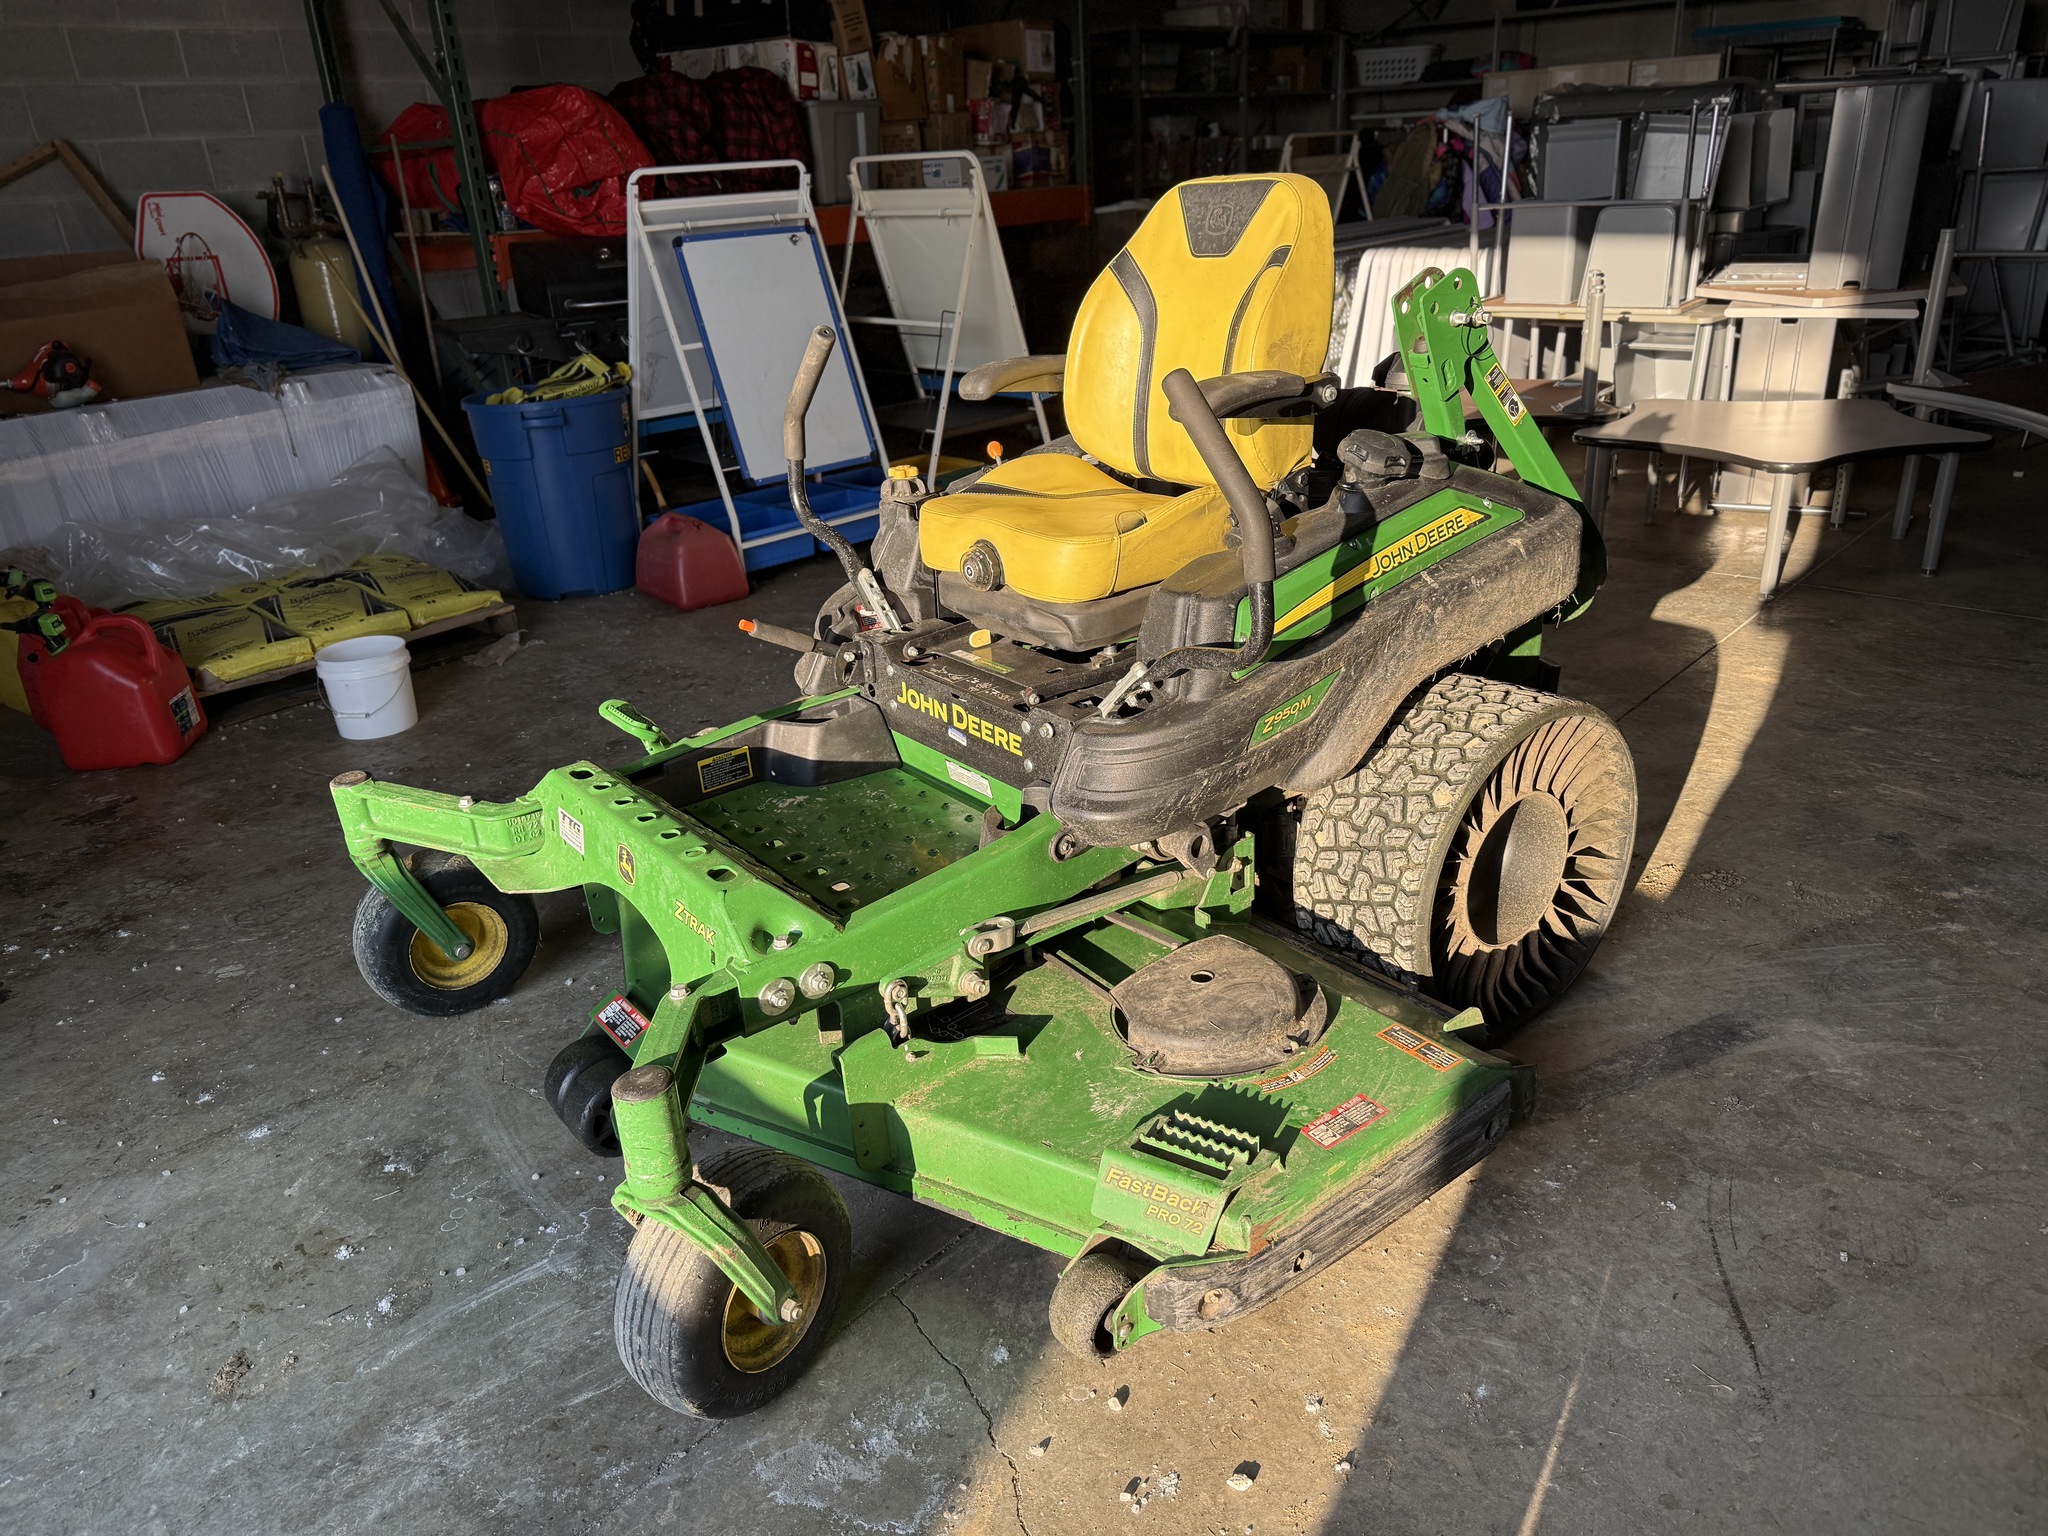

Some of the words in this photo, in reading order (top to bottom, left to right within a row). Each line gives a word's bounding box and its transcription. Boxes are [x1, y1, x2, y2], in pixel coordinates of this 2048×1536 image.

[1372, 541, 1413, 576] JOHN
[1414, 514, 1466, 551] DEERE
[897, 681, 948, 723] JOHN
[952, 703, 1023, 757] DEERE
[1262, 694, 1312, 735] Z950M
[560, 811, 581, 834] TTG
[674, 899, 716, 947] ZTRAK
[1146, 1204, 1181, 1226] PRO
[1183, 1218, 1204, 1235] 72
